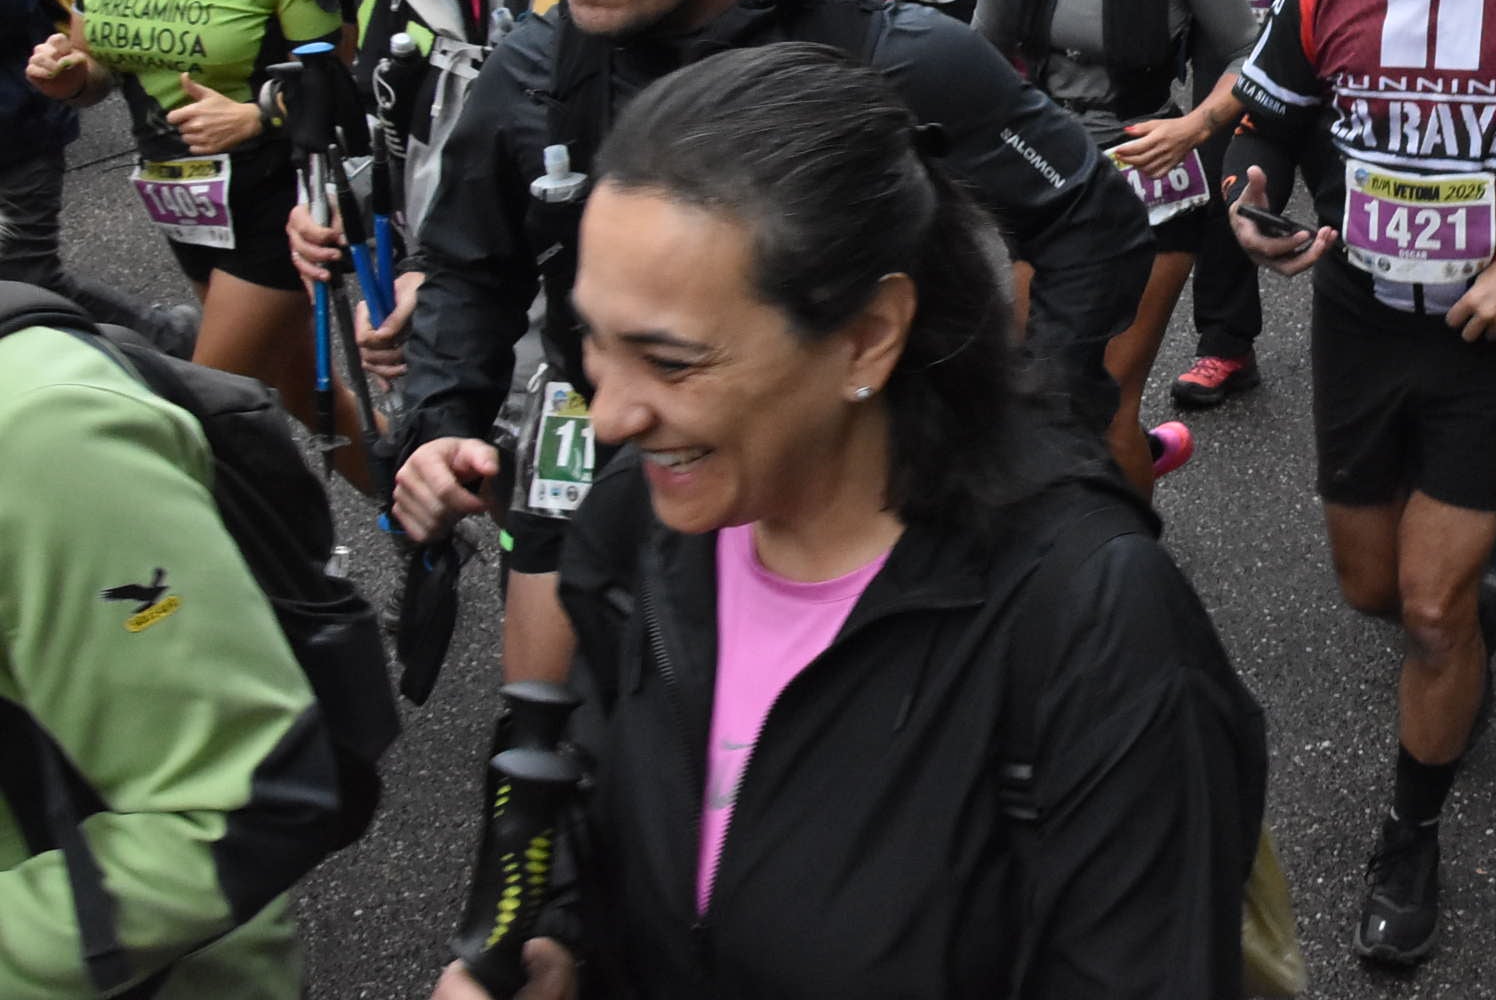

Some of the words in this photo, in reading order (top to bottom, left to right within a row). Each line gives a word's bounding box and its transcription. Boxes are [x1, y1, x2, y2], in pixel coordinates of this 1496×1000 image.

[86, 18, 208, 59] ARBAJOSA
[1001, 127, 1067, 190] SALOMON
[144, 183, 218, 218] 1405
[1363, 198, 1468, 251] 1421
